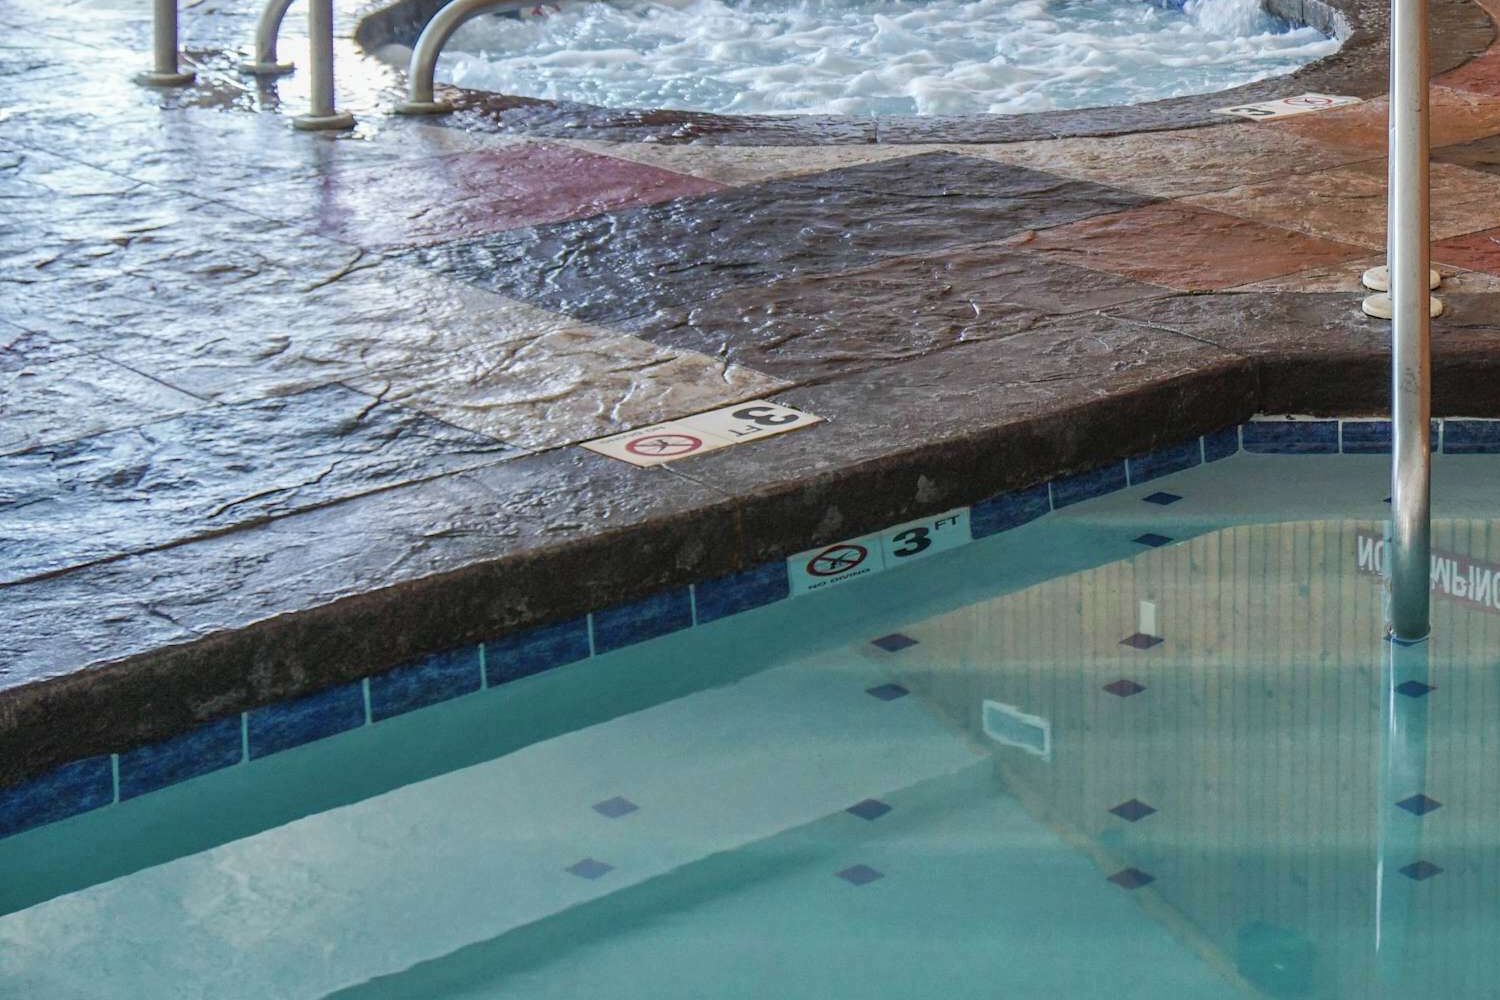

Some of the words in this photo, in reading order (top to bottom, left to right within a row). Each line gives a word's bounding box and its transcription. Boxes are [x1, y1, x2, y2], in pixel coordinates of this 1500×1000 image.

[732, 406, 799, 426] 3
[730, 425, 764, 438] FT
[892, 526, 933, 558] 3
[934, 514, 962, 532] FT
[808, 580, 827, 590] NO
[829, 567, 872, 584] DIVING
